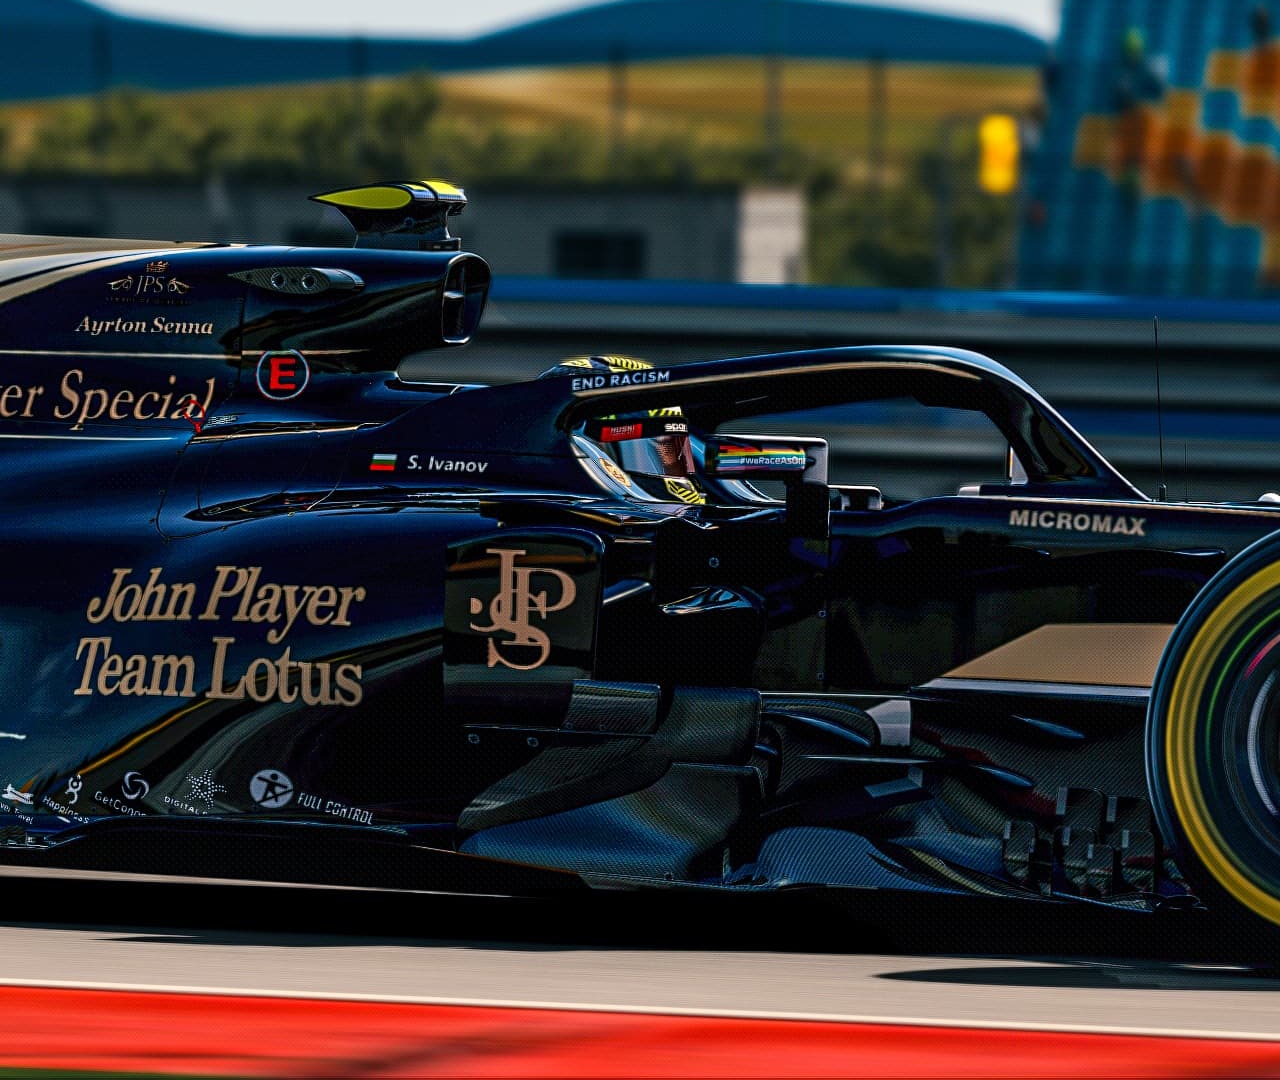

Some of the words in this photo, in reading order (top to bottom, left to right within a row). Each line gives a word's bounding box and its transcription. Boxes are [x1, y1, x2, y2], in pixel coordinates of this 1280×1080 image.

[135, 275, 168, 296] JPS
[75, 316, 147, 336] Ayrton
[151, 317, 214, 335] Senna
[269, 358, 296, 390] E
[571, 375, 606, 391] END
[610, 370, 671, 387] RACISM
[53, 369, 216, 431] Special
[407, 455, 423, 470] S.
[428, 456, 489, 473] Ivanov
[1008, 509, 1147, 537] MICROMAX
[86, 567, 197, 624] John
[198, 565, 367, 645] Player
[73, 636, 197, 698] Team
[205, 636, 363, 707] Lotus
[297, 792, 323, 811] FULL
[325, 800, 374, 825] CONTROL
